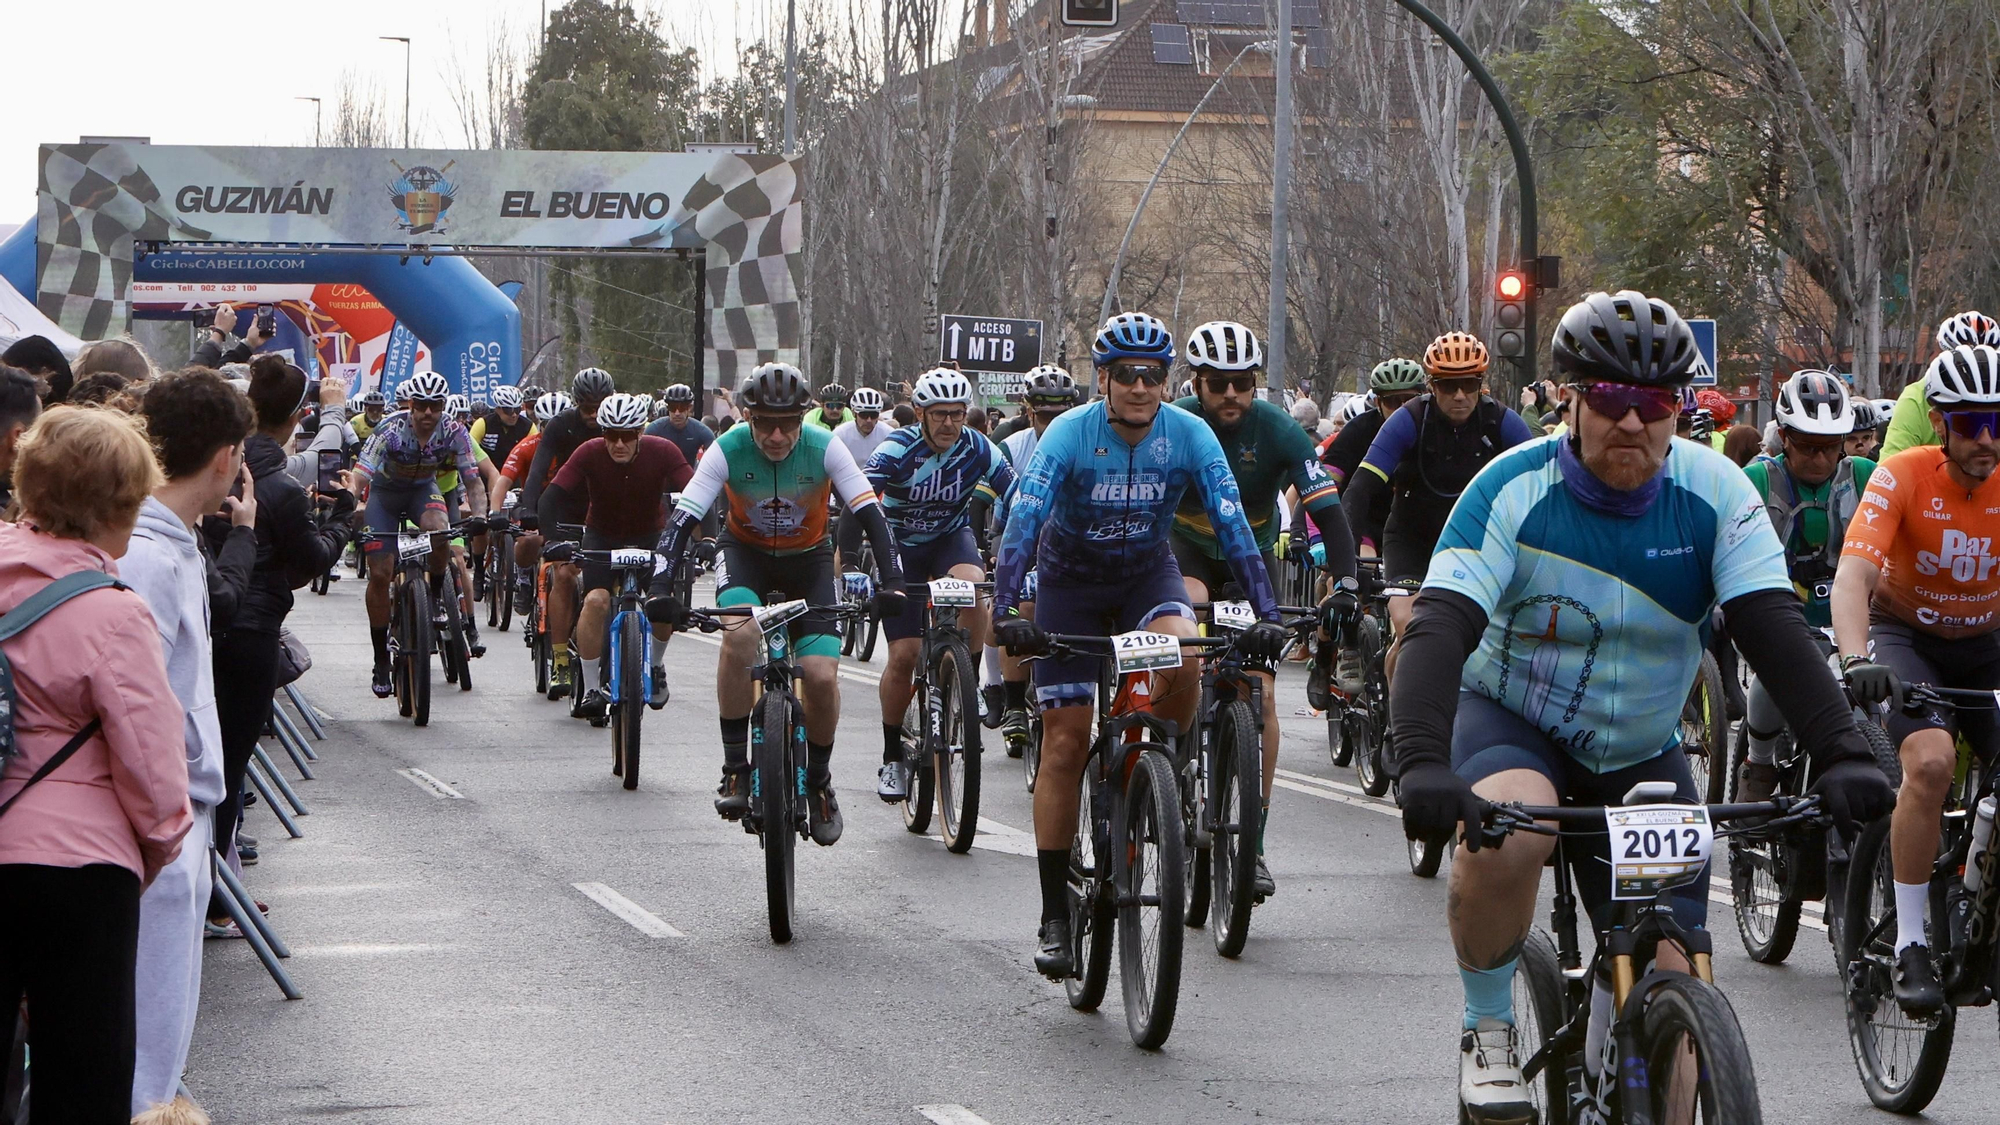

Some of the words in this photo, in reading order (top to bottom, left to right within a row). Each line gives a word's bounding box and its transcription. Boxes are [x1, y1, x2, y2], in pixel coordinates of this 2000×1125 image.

[175, 179, 334, 215] GUZMÁN
[500, 191, 541, 218] EL
[547, 191, 670, 219] BUENO
[200, 284, 217, 292] 902
[221, 284, 237, 292] 432
[242, 284, 257, 292] 100
[329, 301, 359, 310] FUERZAS
[973, 321, 1012, 335] ACCESO
[968, 336, 1015, 362] MTB
[383, 324, 404, 406] CABELLO
[468, 342, 488, 405] CABE
[978, 384, 1025, 395] CERVECE
[1091, 482, 1167, 501] HENRY
[1300, 479, 1336, 496] kutxaba
[1923, 510, 1951, 521] GILMAR
[616, 555, 646, 565] 1069
[935, 581, 969, 590] 1204
[1915, 586, 1958, 603] Grupo
[1222, 606, 1252, 617] 107
[1121, 634, 1170, 648] 2105
[1623, 828, 1700, 859] 2012
